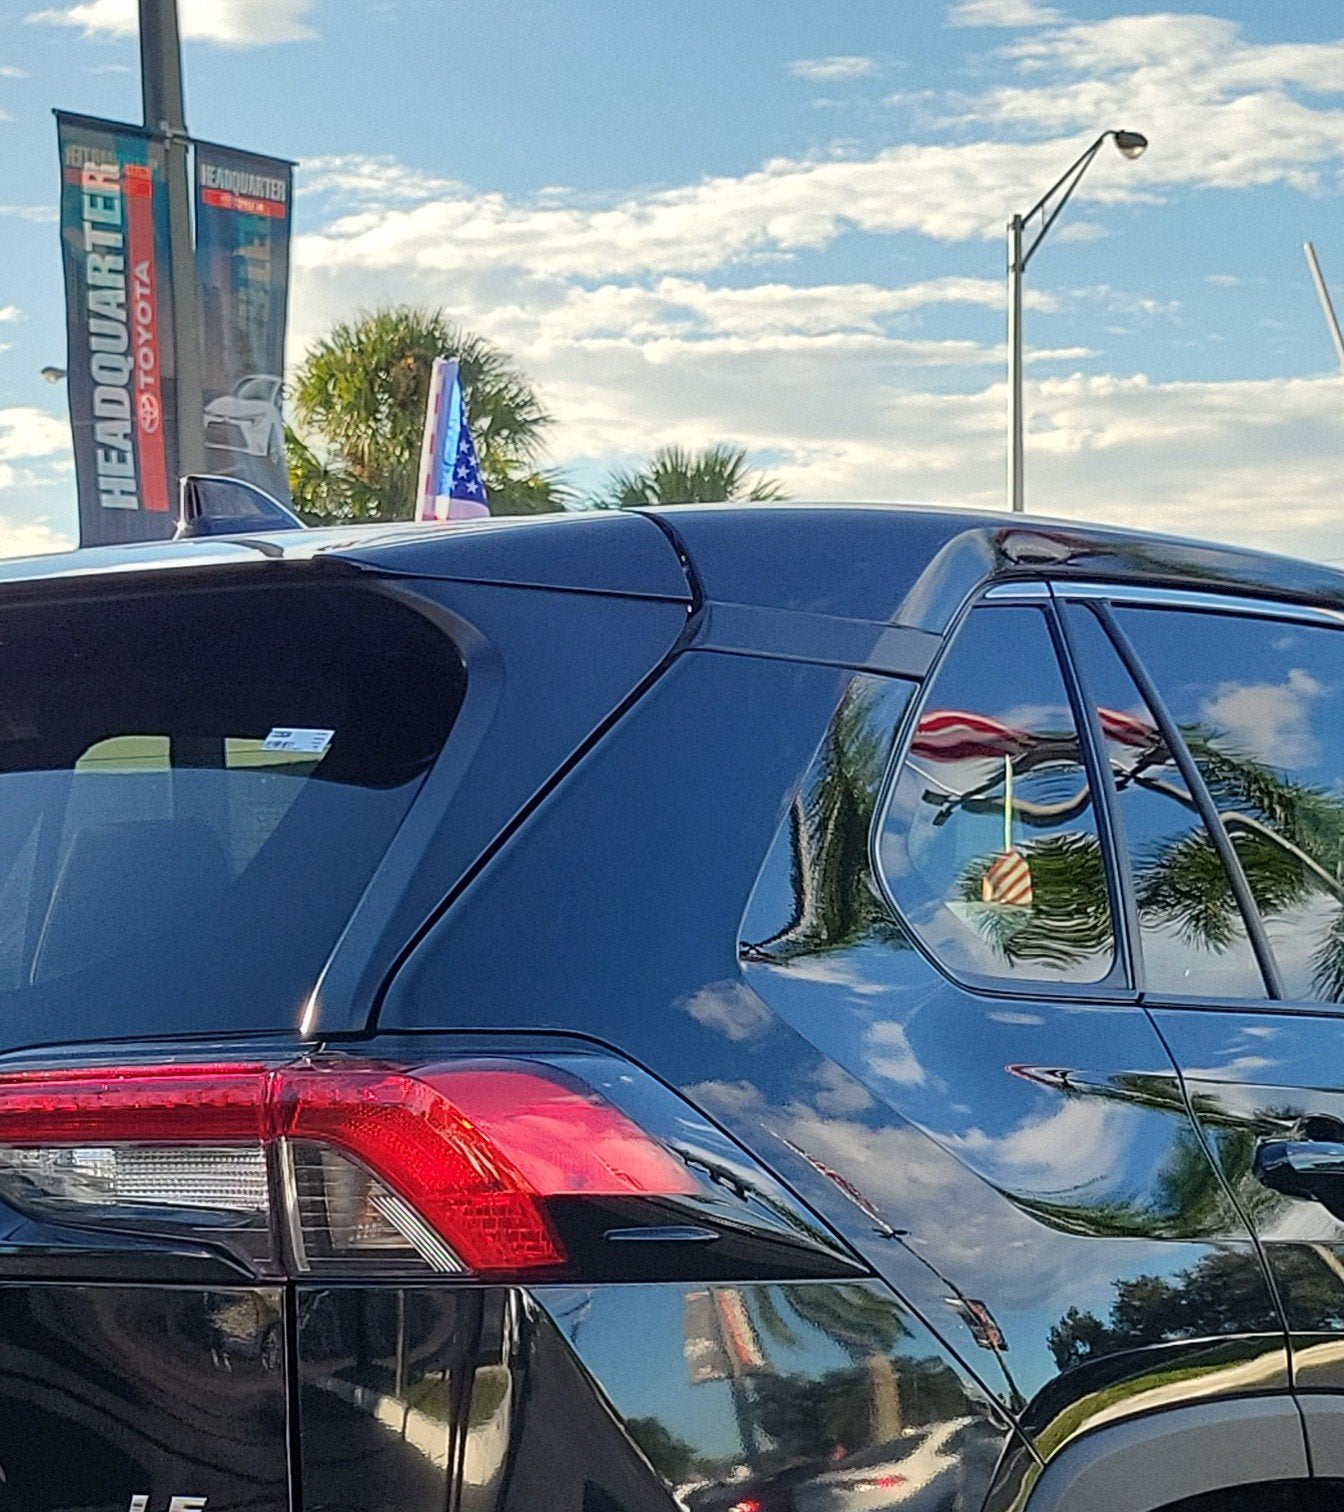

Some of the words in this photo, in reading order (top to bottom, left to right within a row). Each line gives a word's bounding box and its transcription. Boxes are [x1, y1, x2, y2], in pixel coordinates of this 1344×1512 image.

[201, 163, 286, 202] HEADQUARTER
[83, 161, 139, 510] HEADQUARTER
[131, 260, 156, 389] TOYOTA
